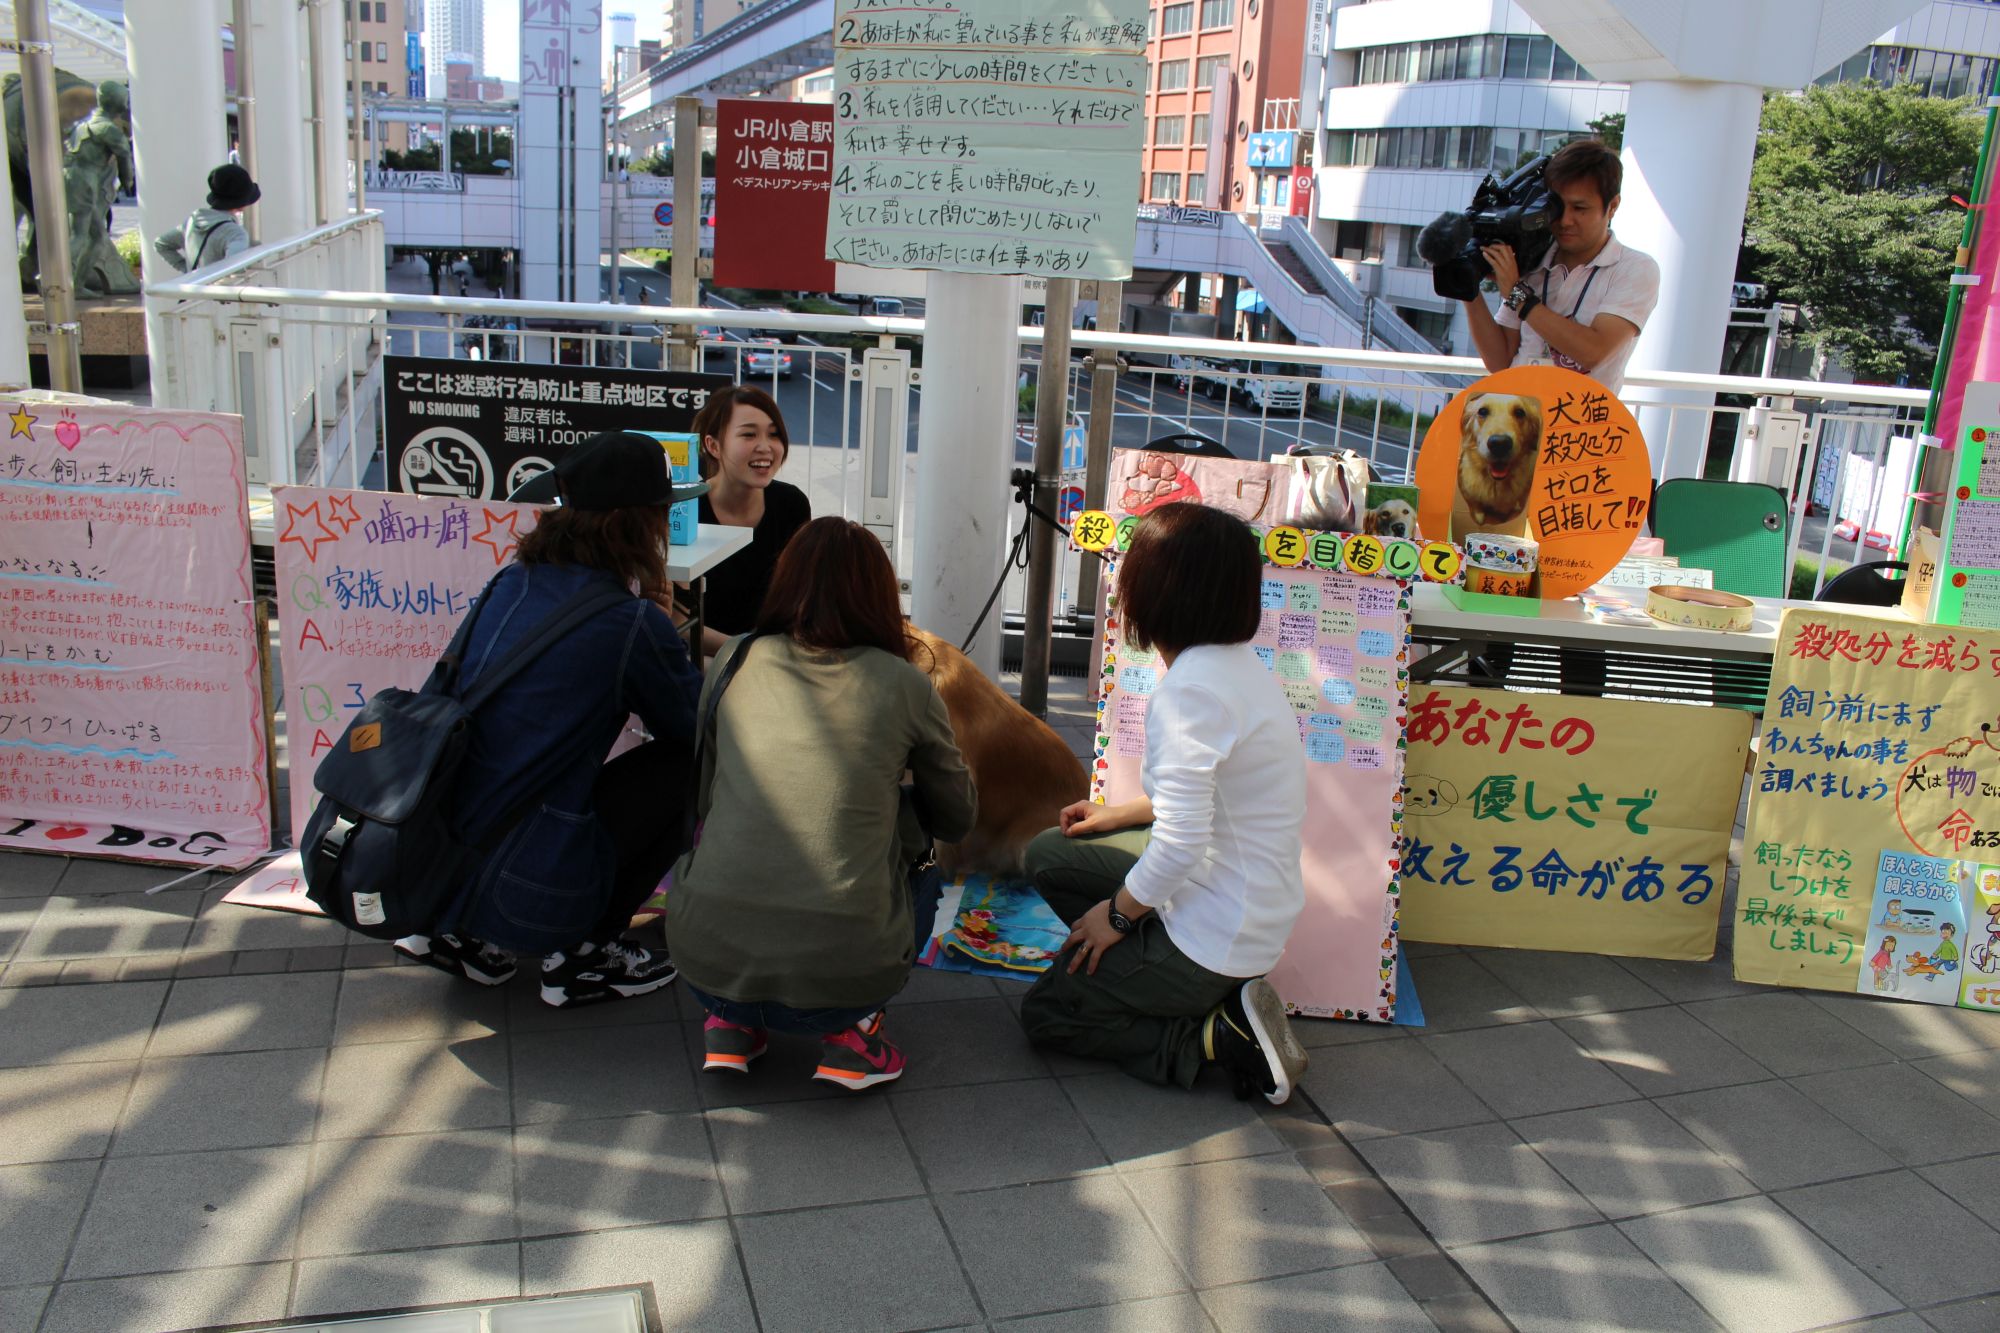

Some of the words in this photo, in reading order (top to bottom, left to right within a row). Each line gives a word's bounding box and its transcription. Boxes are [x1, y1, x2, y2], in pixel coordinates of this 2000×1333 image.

[846, 57, 1134, 88] するまでに少しの時間をください。
[734, 118, 832, 143] JR小倉駅
[846, 127, 977, 157] 私は幸せです。
[736, 146, 828, 171] 小倉城口
[733, 177, 831, 191] ペデストリアンデッキ
[838, 200, 1101, 234] そして罰として閉じこめたりしないで
[833, 237, 1090, 271] ください。あなたには仕事があり
[398, 372, 711, 410] ここは迷惑行為防止重点地区です
[409, 400, 424, 415] NO
[427, 402, 480, 419] SMOKING
[504, 406, 573, 426] 違反者は、
[1548, 391, 1609, 427] 犬猫
[504, 426, 601, 446] 過料1,000
[1543, 426, 1630, 465] 殺処分
[1544, 465, 1615, 500] ゼロを
[364, 499, 471, 549] 噛み癖
[326, 565, 482, 616] 家族以外に
[1407, 691, 1595, 756] あなたの
[1778, 684, 1943, 732] 飼う前にまず
[0, 713, 162, 742] グイグイひっぱる
[1765, 727, 1909, 765] わんちゃんの事を
[1760, 761, 1889, 801] 調べましょう
[1467, 774, 1658, 835] 優しさで
[1754, 840, 1852, 871] 飼ったなら
[1882, 855, 1946, 880] ほんとうに
[1769, 870, 1852, 899] しつけを
[1883, 876, 1957, 901] 飼えるかな
[1742, 898, 1845, 930] 最後まで
[1769, 928, 1854, 964] しましょう
